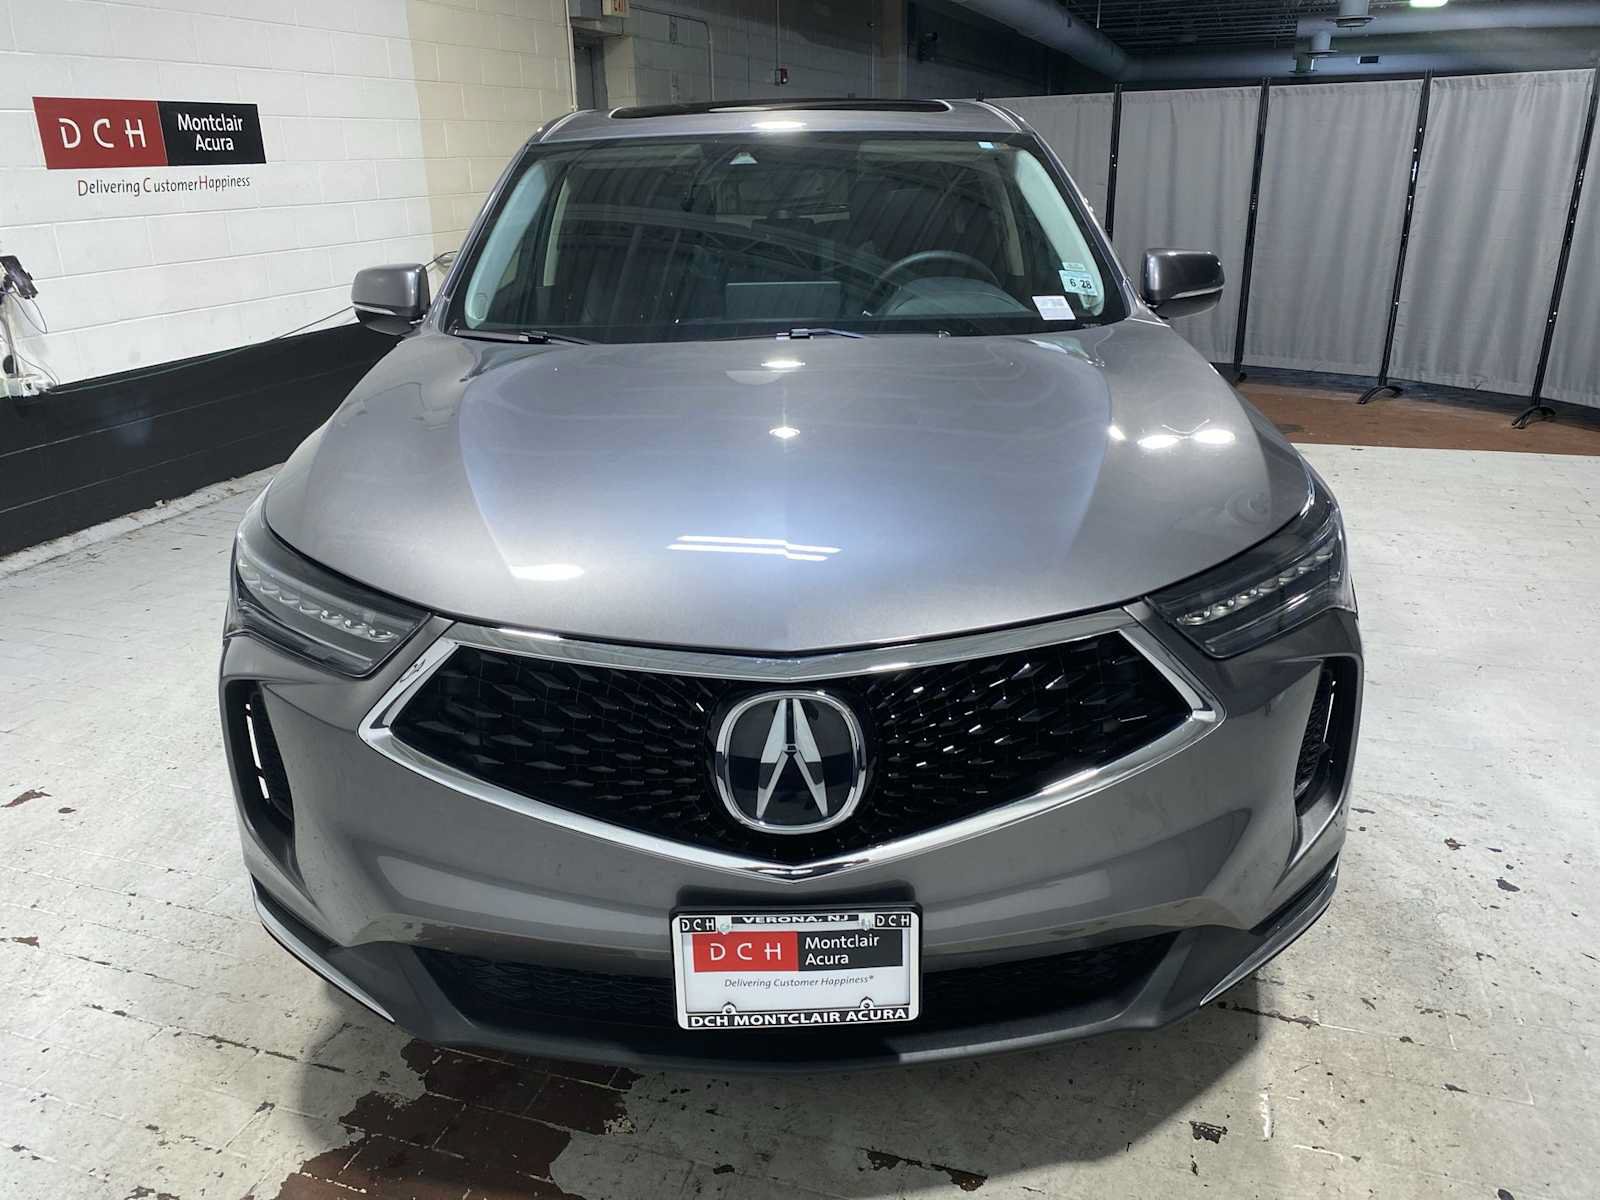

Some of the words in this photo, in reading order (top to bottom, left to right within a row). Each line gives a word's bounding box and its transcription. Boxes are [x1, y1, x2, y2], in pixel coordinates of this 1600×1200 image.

[177, 113, 244, 132] Montclair
[58, 117, 147, 149] DCH
[195, 134, 235, 151] Acura
[77, 178, 141, 197] Delivering
[681, 918, 715, 932] DCH
[827, 914, 849, 922] NJ
[876, 914, 910, 927] DCH
[805, 934, 880, 950] Montclair
[710, 943, 782, 961] DCH
[805, 952, 849, 966] Acura
[724, 978, 771, 989] Delivering
[773, 978, 819, 988] Customer
[691, 1014, 729, 1028] DCH
[733, 1011, 842, 1026] MONTCLAIR
[848, 1007, 907, 1022] ACURA
